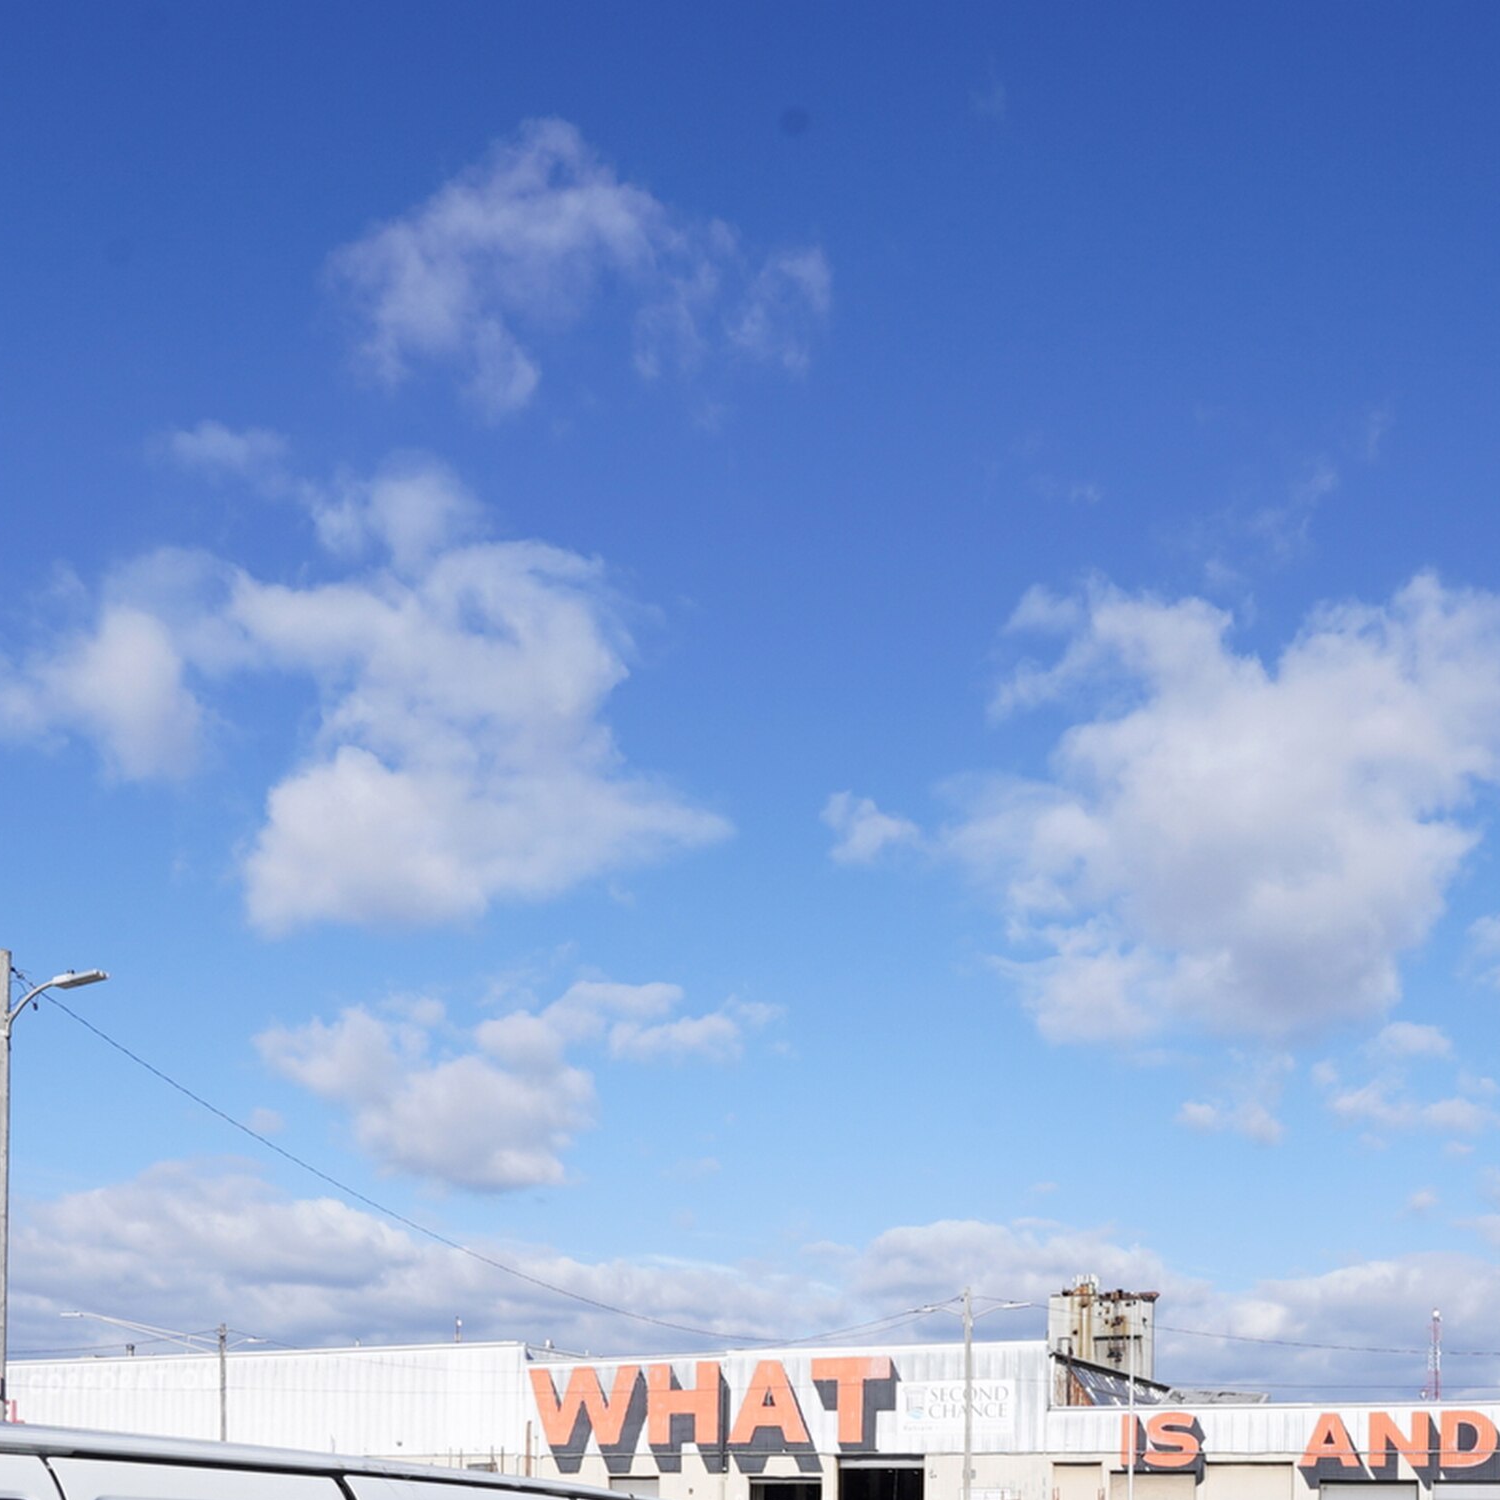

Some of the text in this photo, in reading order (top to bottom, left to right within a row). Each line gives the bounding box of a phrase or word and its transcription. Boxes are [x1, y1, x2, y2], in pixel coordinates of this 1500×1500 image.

[529, 1356, 893, 1447] WHAT
[1121, 1412, 1200, 1468] IS
[1299, 1410, 1500, 1468] AND
[929, 1385, 1010, 1403] SECOND
